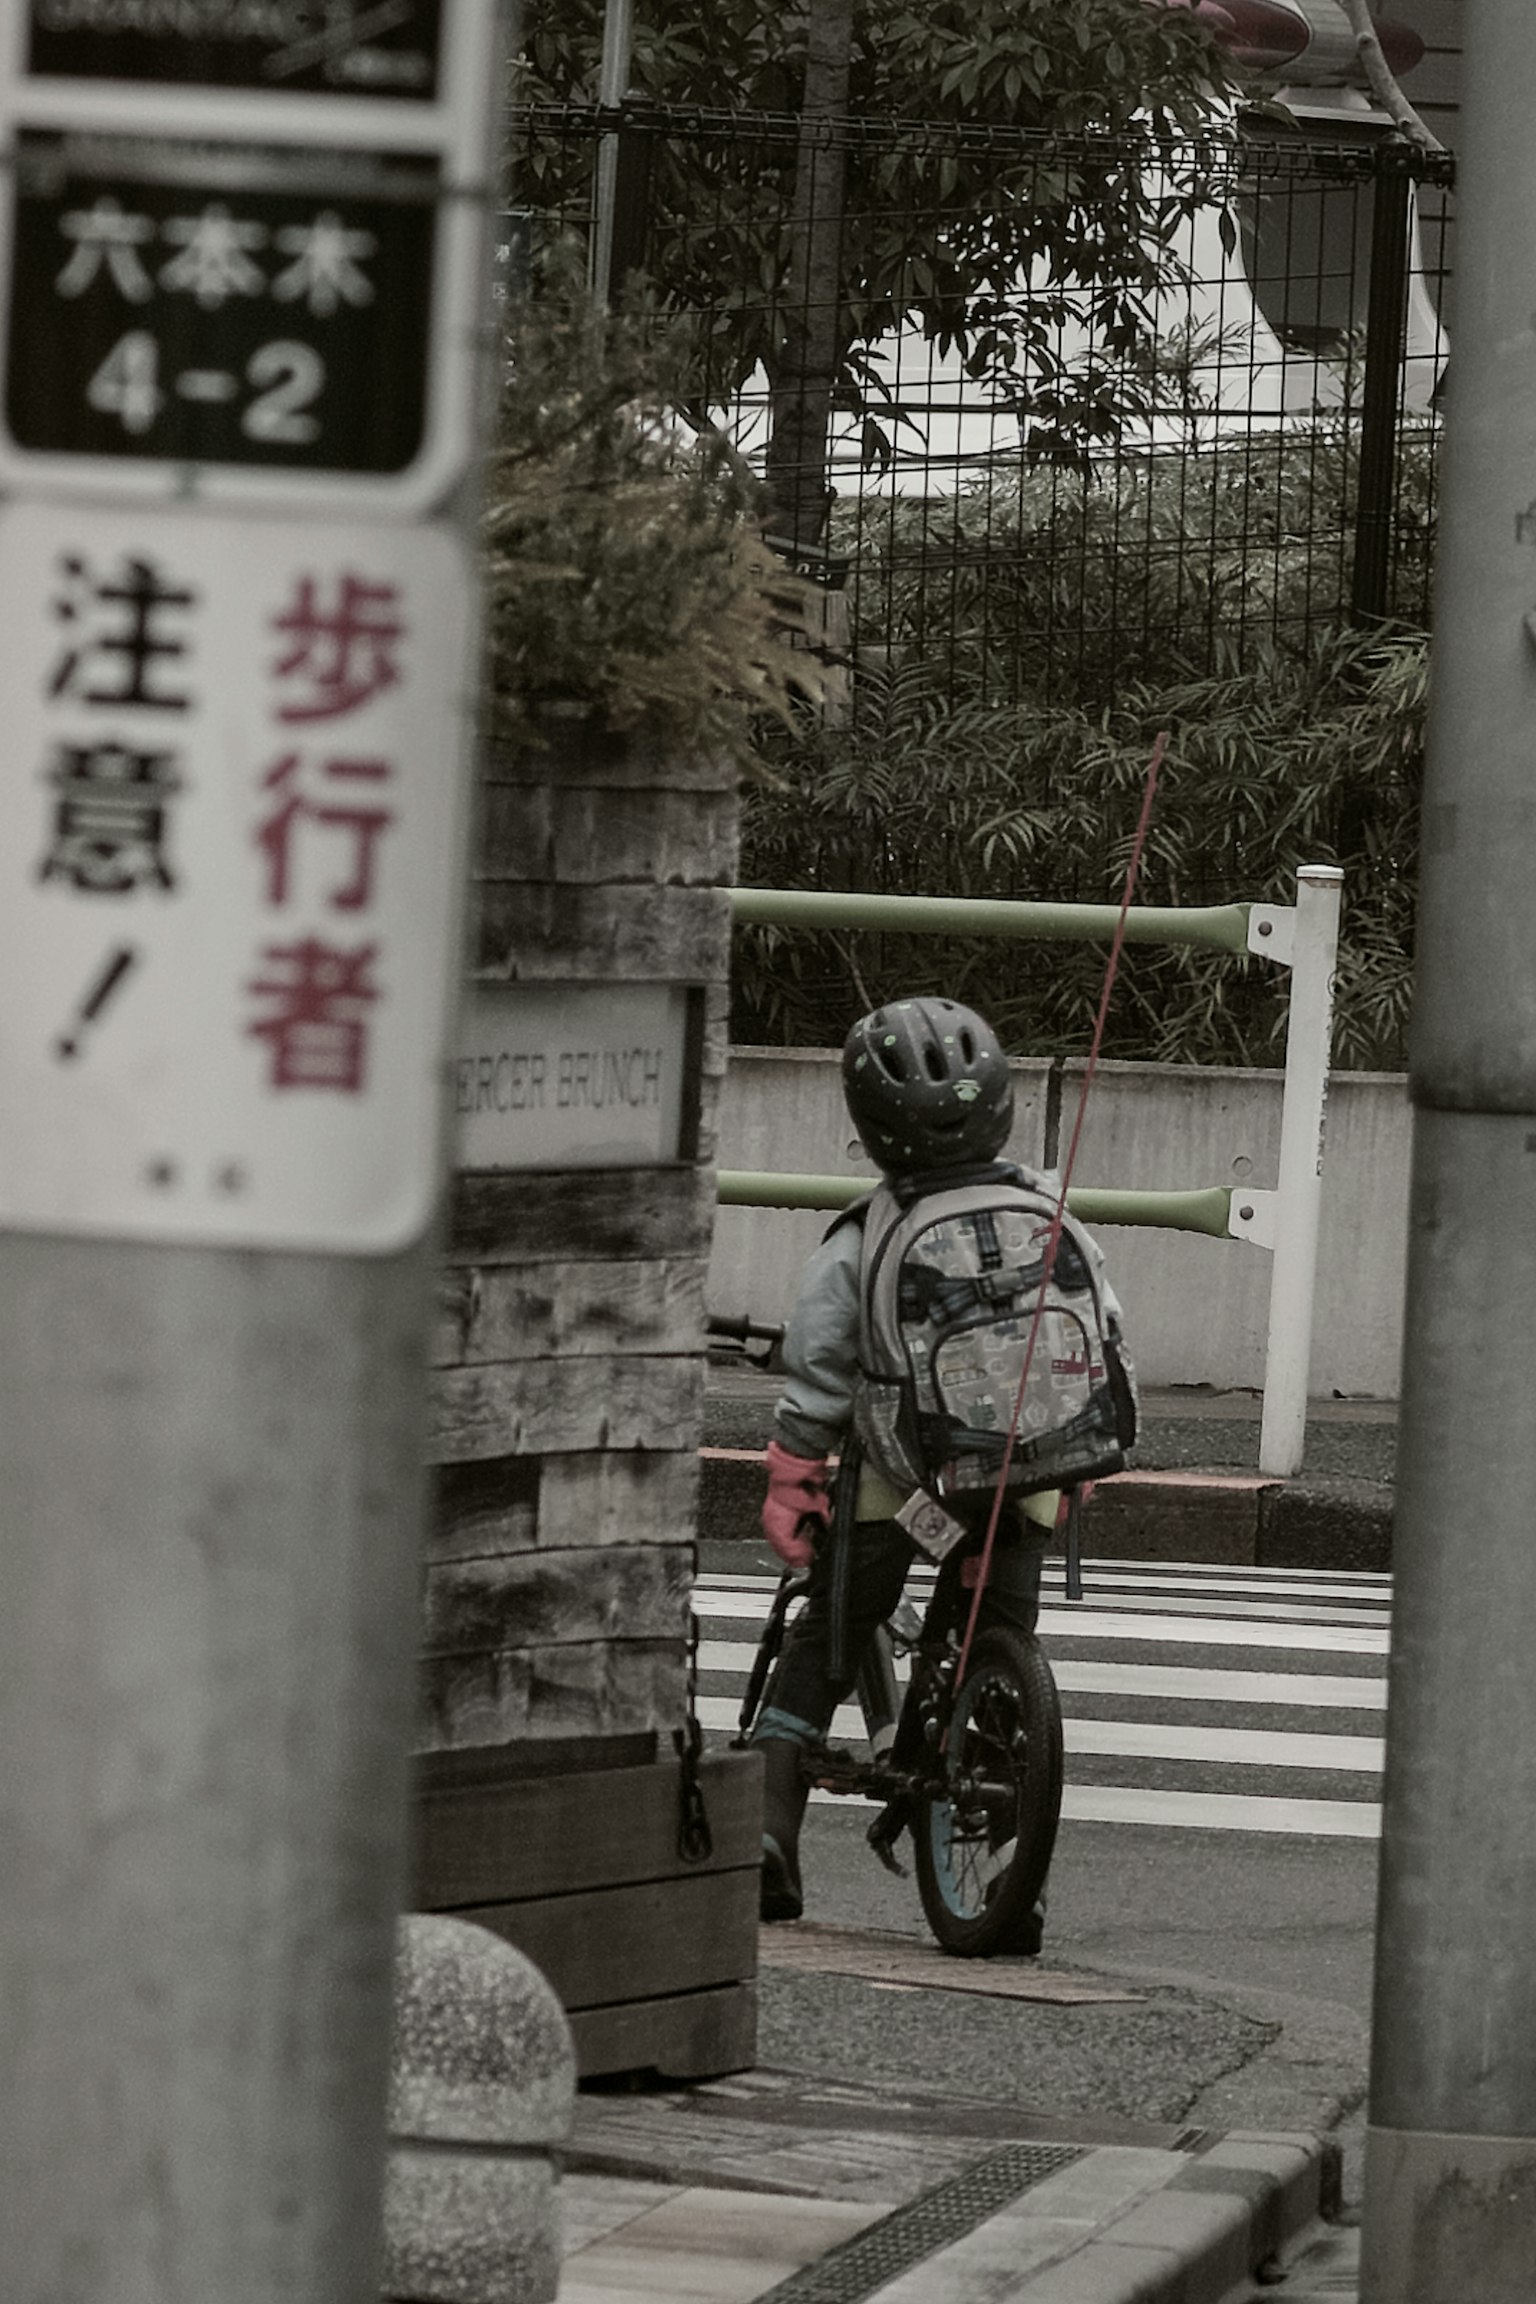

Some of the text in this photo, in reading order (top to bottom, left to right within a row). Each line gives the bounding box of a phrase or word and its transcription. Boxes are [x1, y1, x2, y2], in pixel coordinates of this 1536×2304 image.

[55, 196, 378, 317] 六本木
[87, 329, 326, 445] 4-2
[247, 570, 406, 1097] 歩行者
[455, 1047, 663, 1113] ERCER BRUNCH
